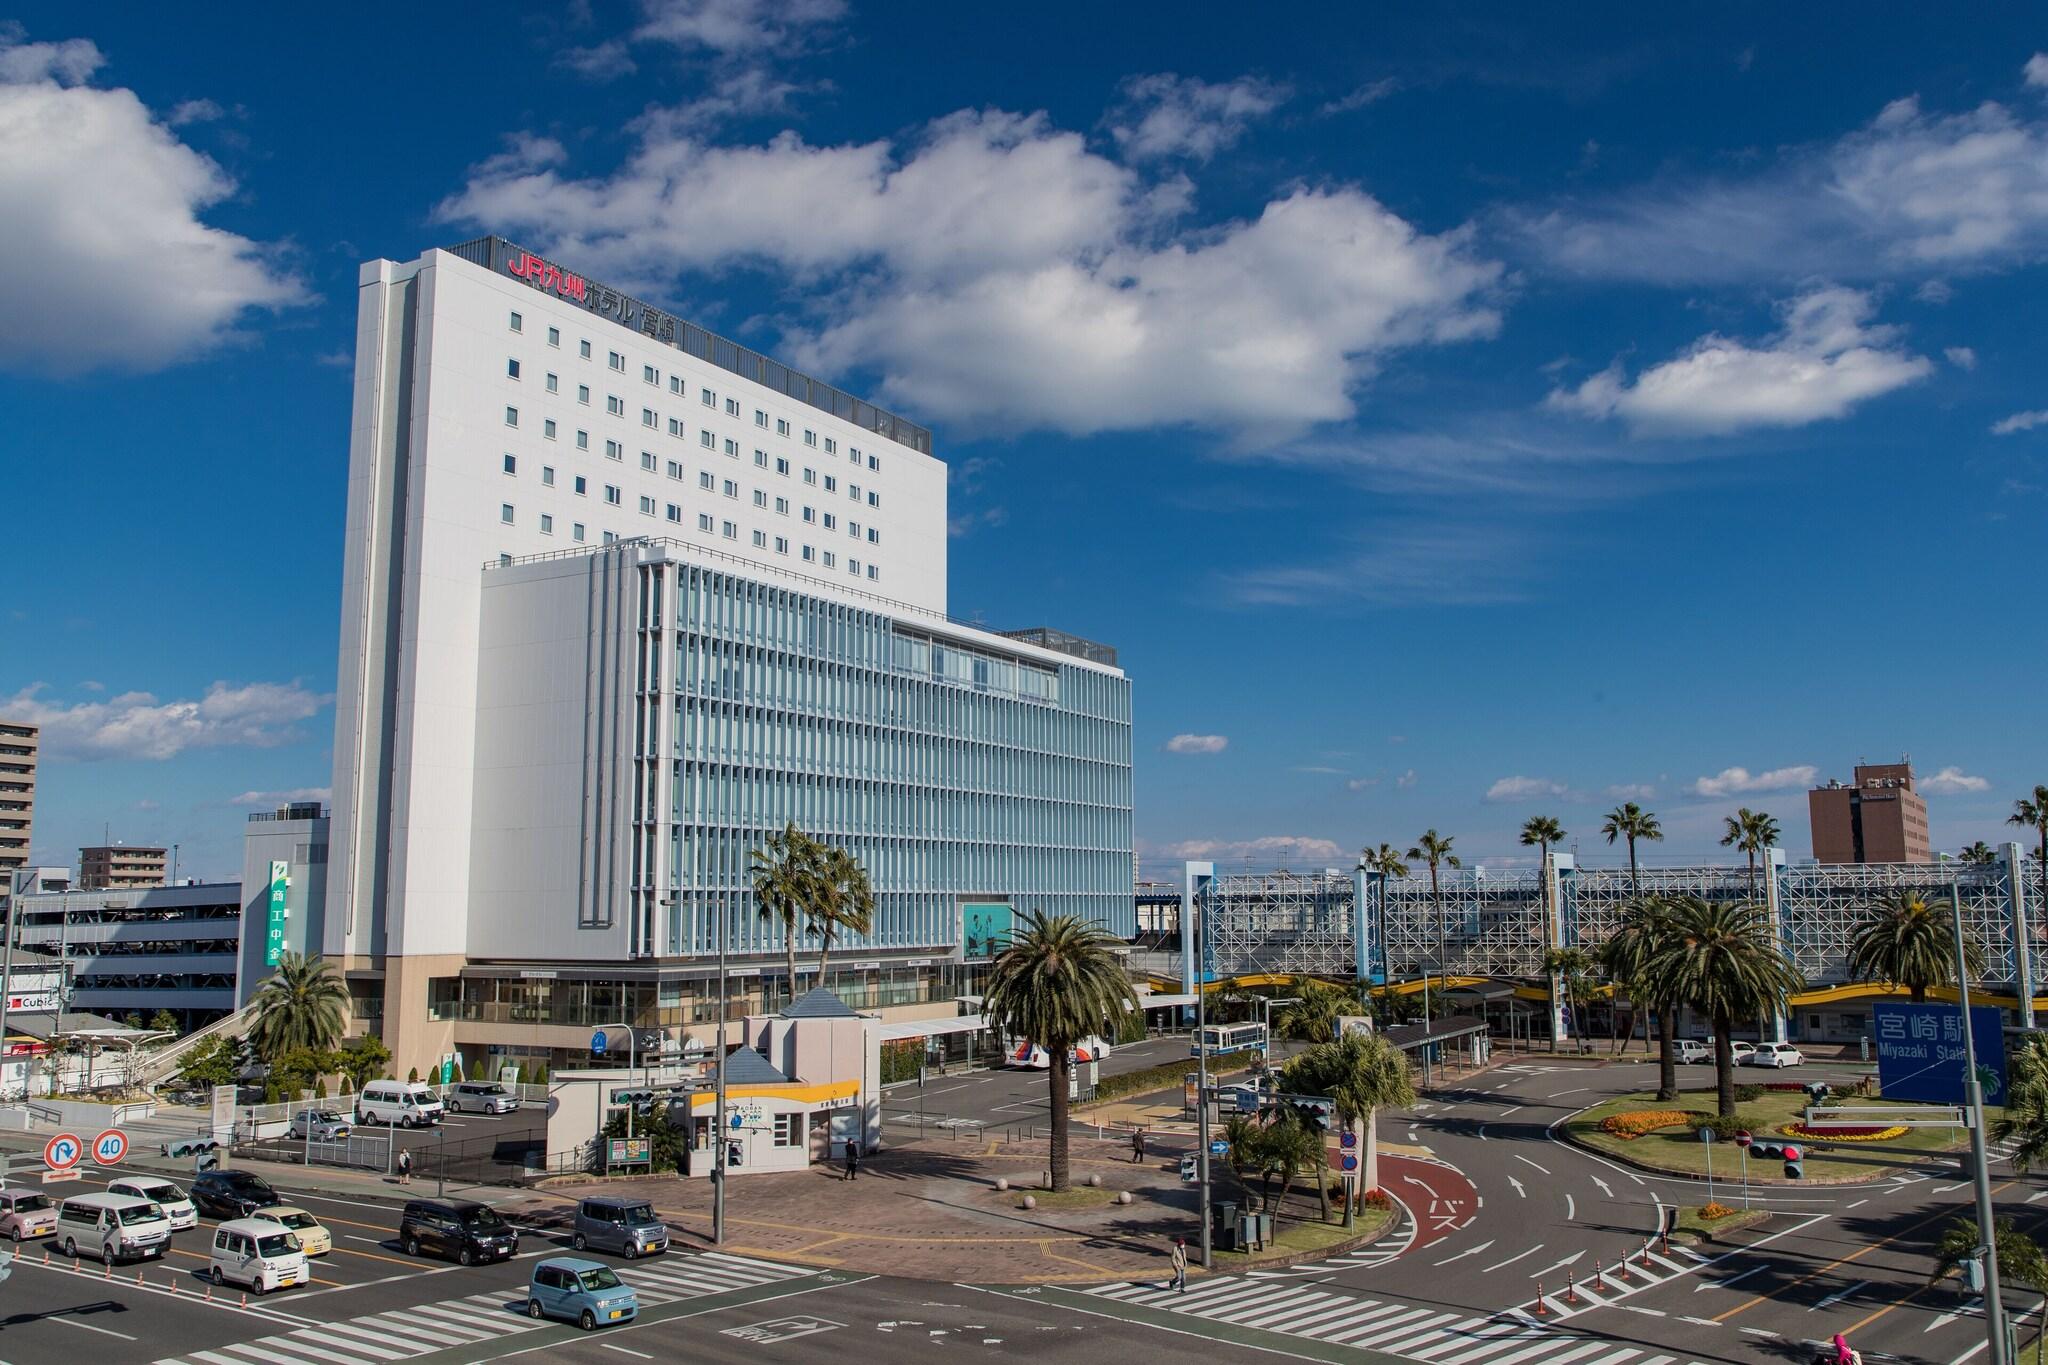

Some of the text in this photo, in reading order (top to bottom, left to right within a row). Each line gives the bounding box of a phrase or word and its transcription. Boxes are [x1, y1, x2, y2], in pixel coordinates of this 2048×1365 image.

[269, 889, 284, 960] 商工中金
[1879, 1012, 1966, 1041] 宮崎駅
[1880, 1042, 1928, 1059] Miyazaki
[100, 1139, 120, 1156] 40
[1429, 1200, 1464, 1230] バス
